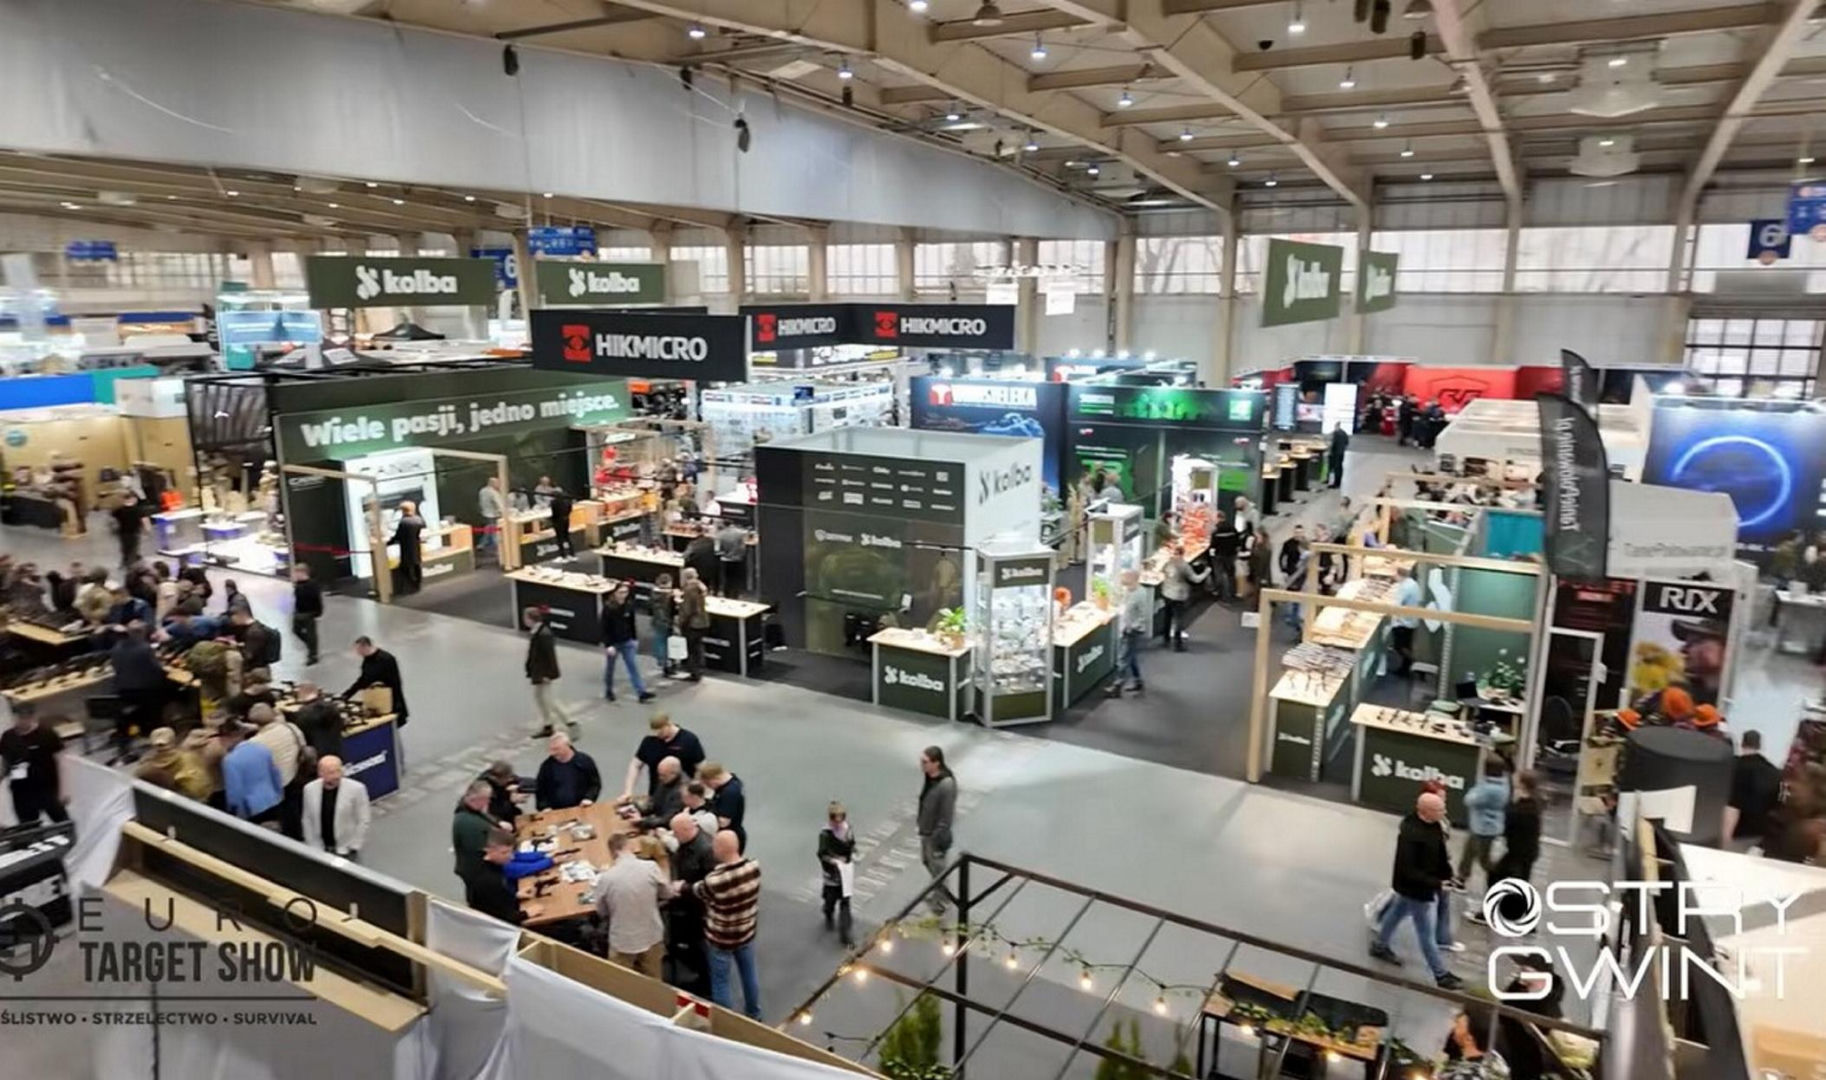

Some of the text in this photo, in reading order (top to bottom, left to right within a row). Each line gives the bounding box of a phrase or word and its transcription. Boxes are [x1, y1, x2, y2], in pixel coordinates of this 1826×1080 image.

[1760, 224, 1786, 247] 6
[382, 269, 458, 293] kolba
[588, 271, 640, 293] kolba
[777, 317, 836, 336] HIKMICRO
[901, 317, 987, 335] HIKMICRO
[595, 333, 708, 361] HIKMICRO
[302, 391, 620, 447] Wiele pasji, jedno miejsce.
[993, 462, 1031, 494] kolba
[1660, 586, 1721, 614] RIX
[899, 670, 945, 692] kolba
[1394, 760, 1465, 790] kolba
